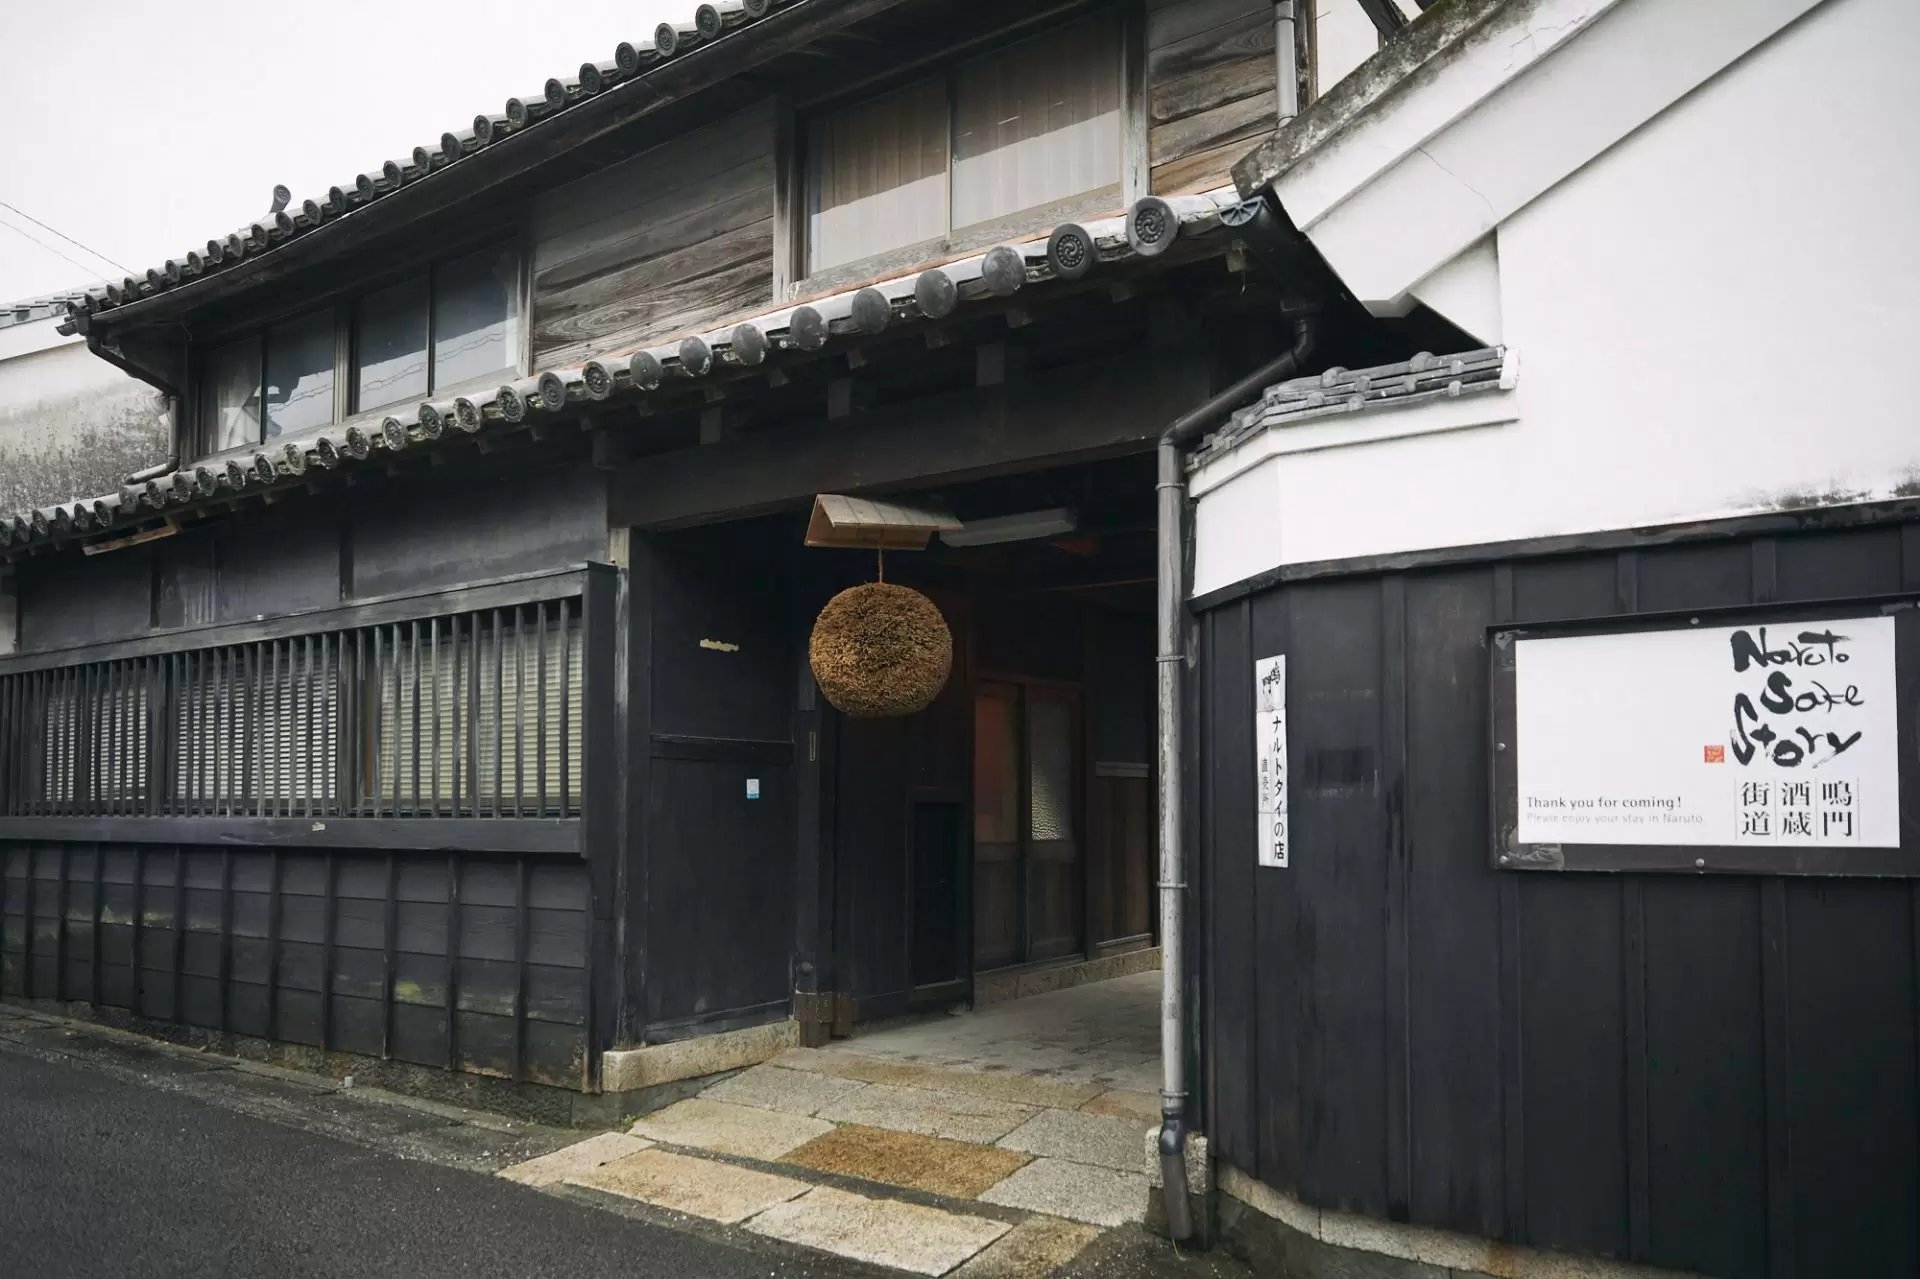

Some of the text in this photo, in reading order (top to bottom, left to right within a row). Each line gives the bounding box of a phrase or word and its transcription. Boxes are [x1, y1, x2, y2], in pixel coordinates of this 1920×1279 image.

[1760, 671, 1864, 714] Sake
[1730, 693, 1862, 768] Story
[1273, 716, 1284, 859] ナルトタイの店
[1527, 797, 1567, 808] Thank
[1570, 798, 1594, 810] you
[1598, 796, 1618, 808] for
[1742, 781, 1771, 836] 街道
[1781, 780, 1812, 836] 酒蔵
[1822, 780, 1852, 837] 鳴門
[1594, 815, 1619, 825] your
[1622, 813, 1645, 825] stay
[1649, 813, 1660, 823] in
